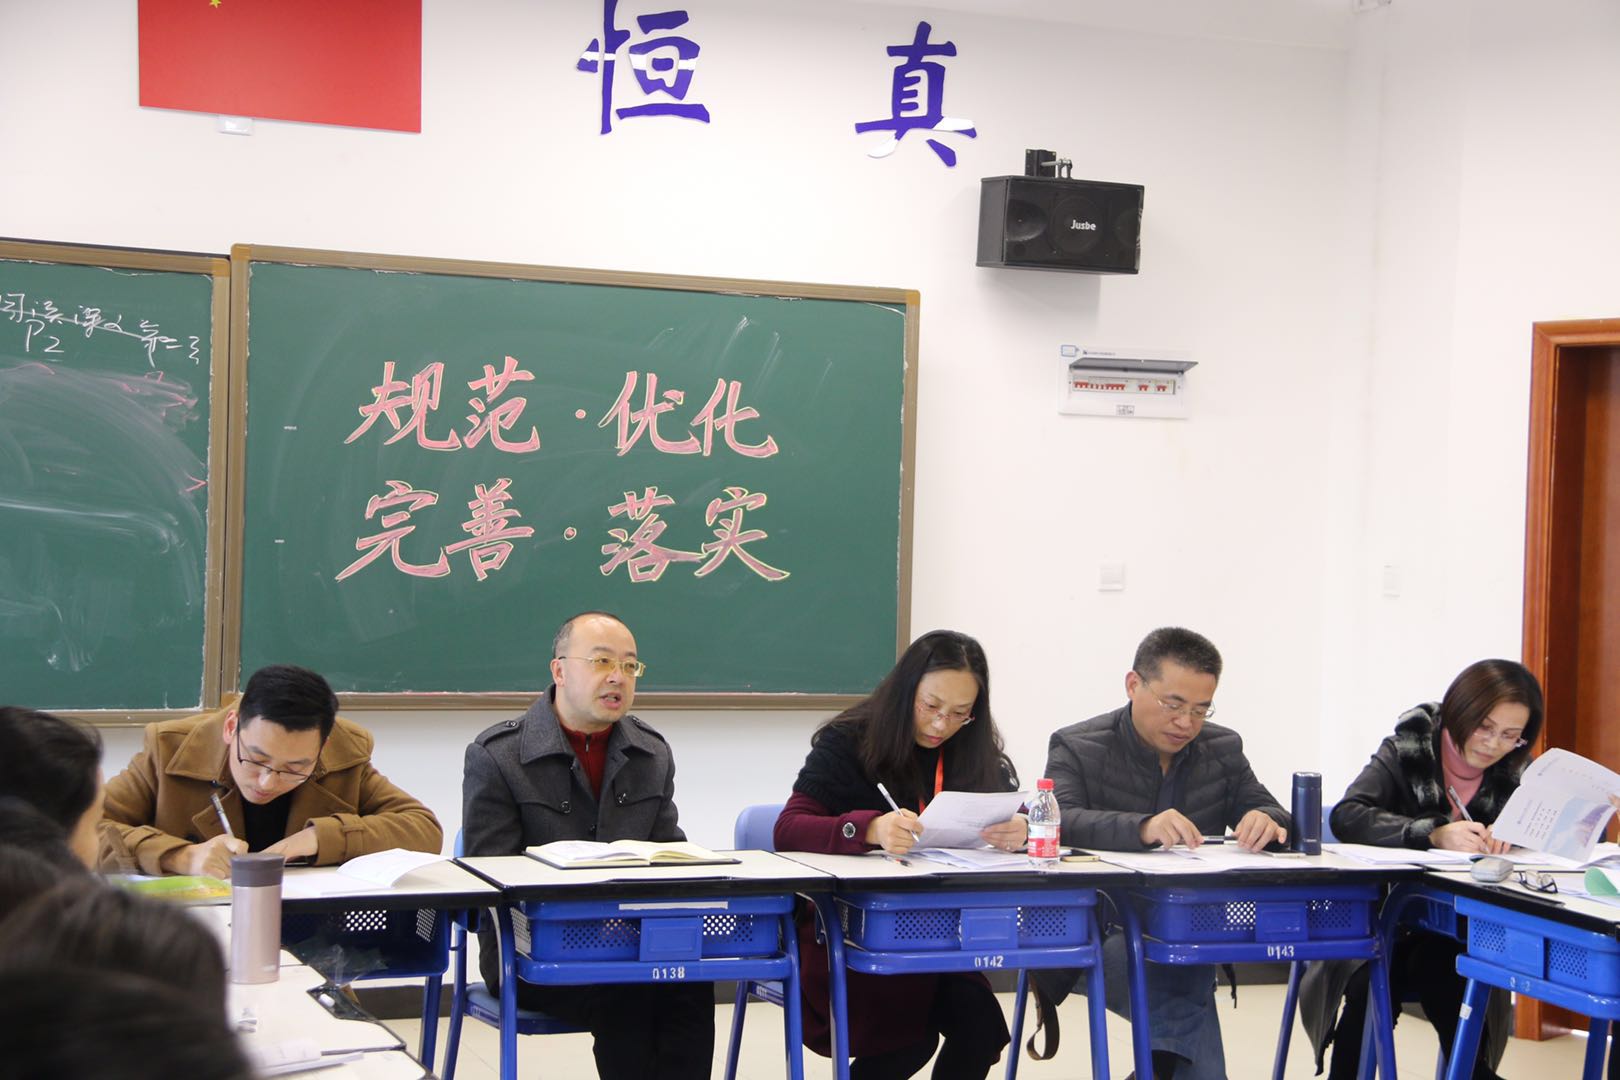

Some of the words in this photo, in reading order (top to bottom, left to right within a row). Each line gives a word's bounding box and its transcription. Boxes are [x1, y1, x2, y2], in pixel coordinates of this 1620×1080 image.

[577, 0, 709, 135] 恒
[855, 21, 977, 168] 真
[1267, 945, 1295, 960] 0143
[974, 955, 1004, 968] 0142
[652, 966, 685, 979] 0138
